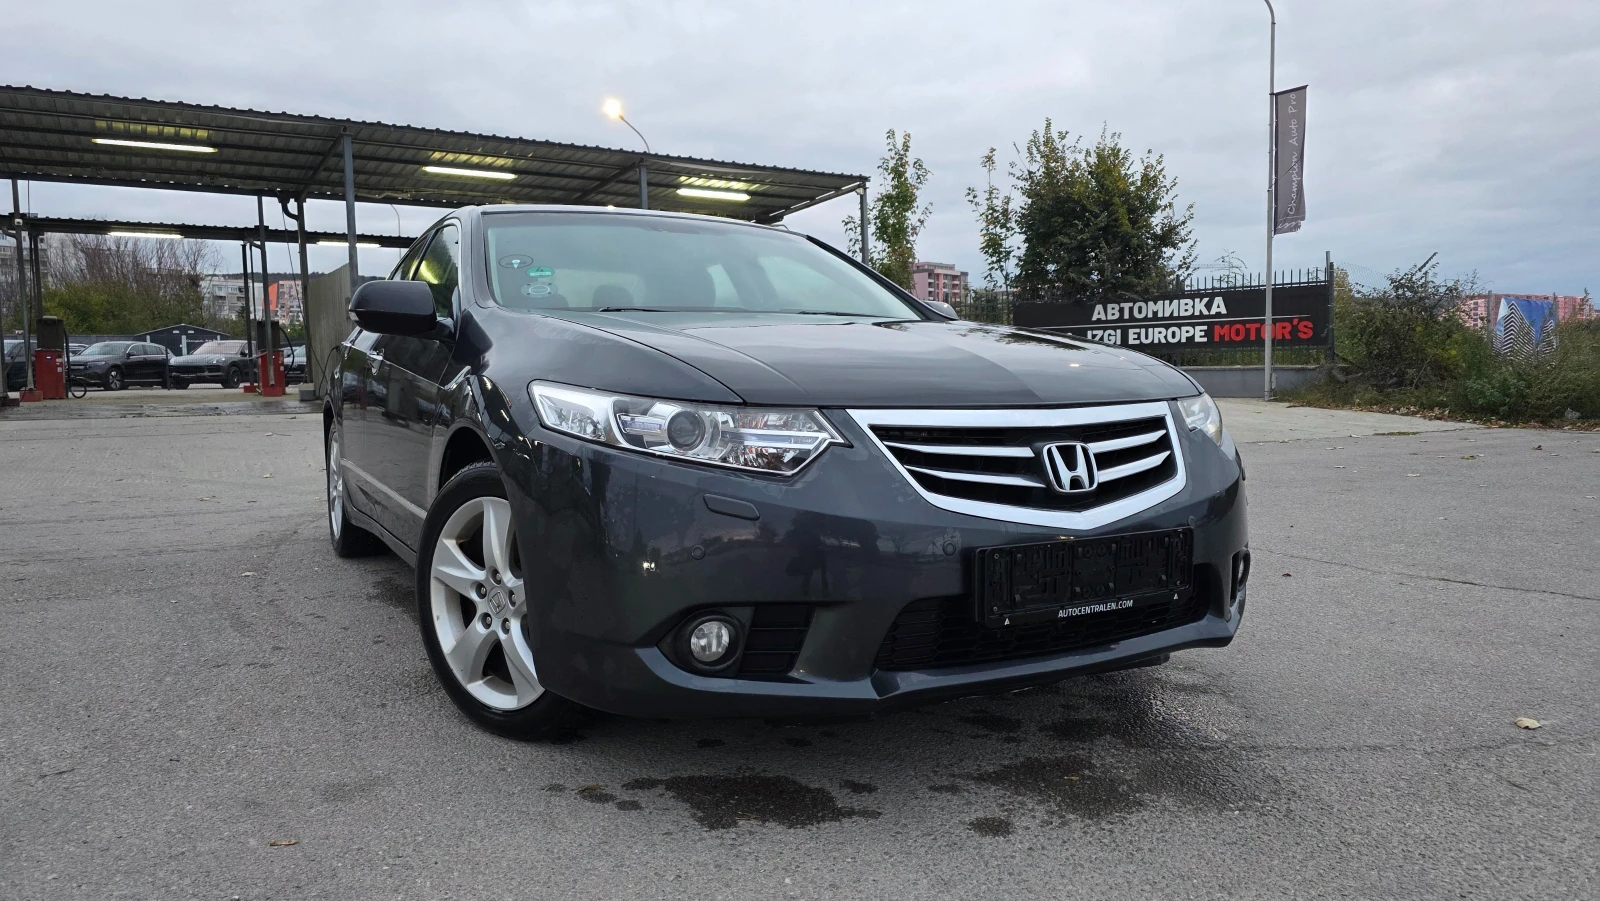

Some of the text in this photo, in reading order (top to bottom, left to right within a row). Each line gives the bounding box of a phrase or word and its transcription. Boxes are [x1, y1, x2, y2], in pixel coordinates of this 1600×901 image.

[1288, 93, 1297, 114] Pro
[1288, 118, 1299, 146] Auto
[1287, 151, 1301, 214] Champion
[1091, 296, 1227, 321] АВТОМИВКА
[1128, 325, 1208, 345] EUROPE
[1213, 318, 1314, 342] MOTOR'S
[1057, 599, 1134, 618] AUTOCENTRALEN.COM
